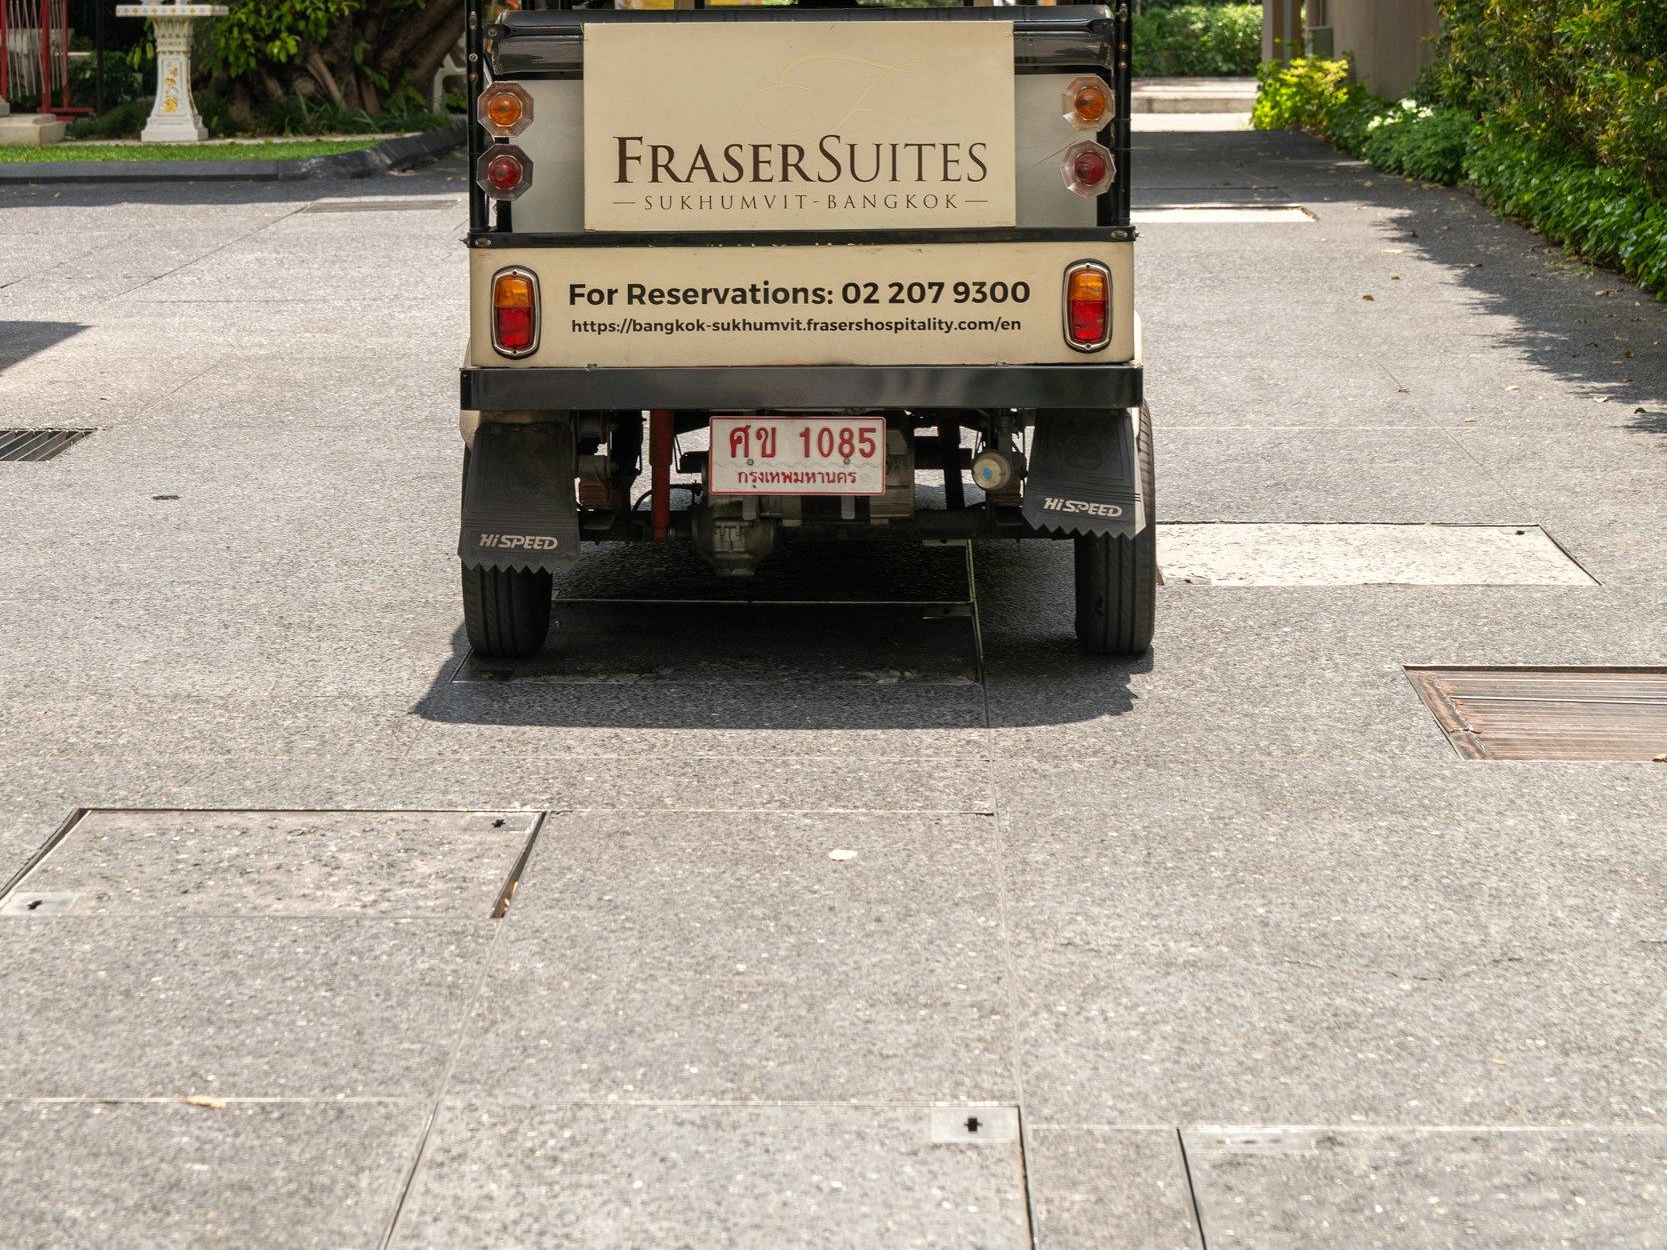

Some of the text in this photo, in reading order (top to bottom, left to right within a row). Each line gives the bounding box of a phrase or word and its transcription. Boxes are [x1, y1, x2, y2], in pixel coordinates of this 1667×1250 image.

[569, 280, 1031, 306] For Reservations: 02 207 9300
[571, 315, 1022, 336] https://bangkok-sukhumvit.frasershospitality.com/en
[729, 425, 877, 459] ศข 1085
[737, 470, 857, 489] กรุงเทพมหานคร
